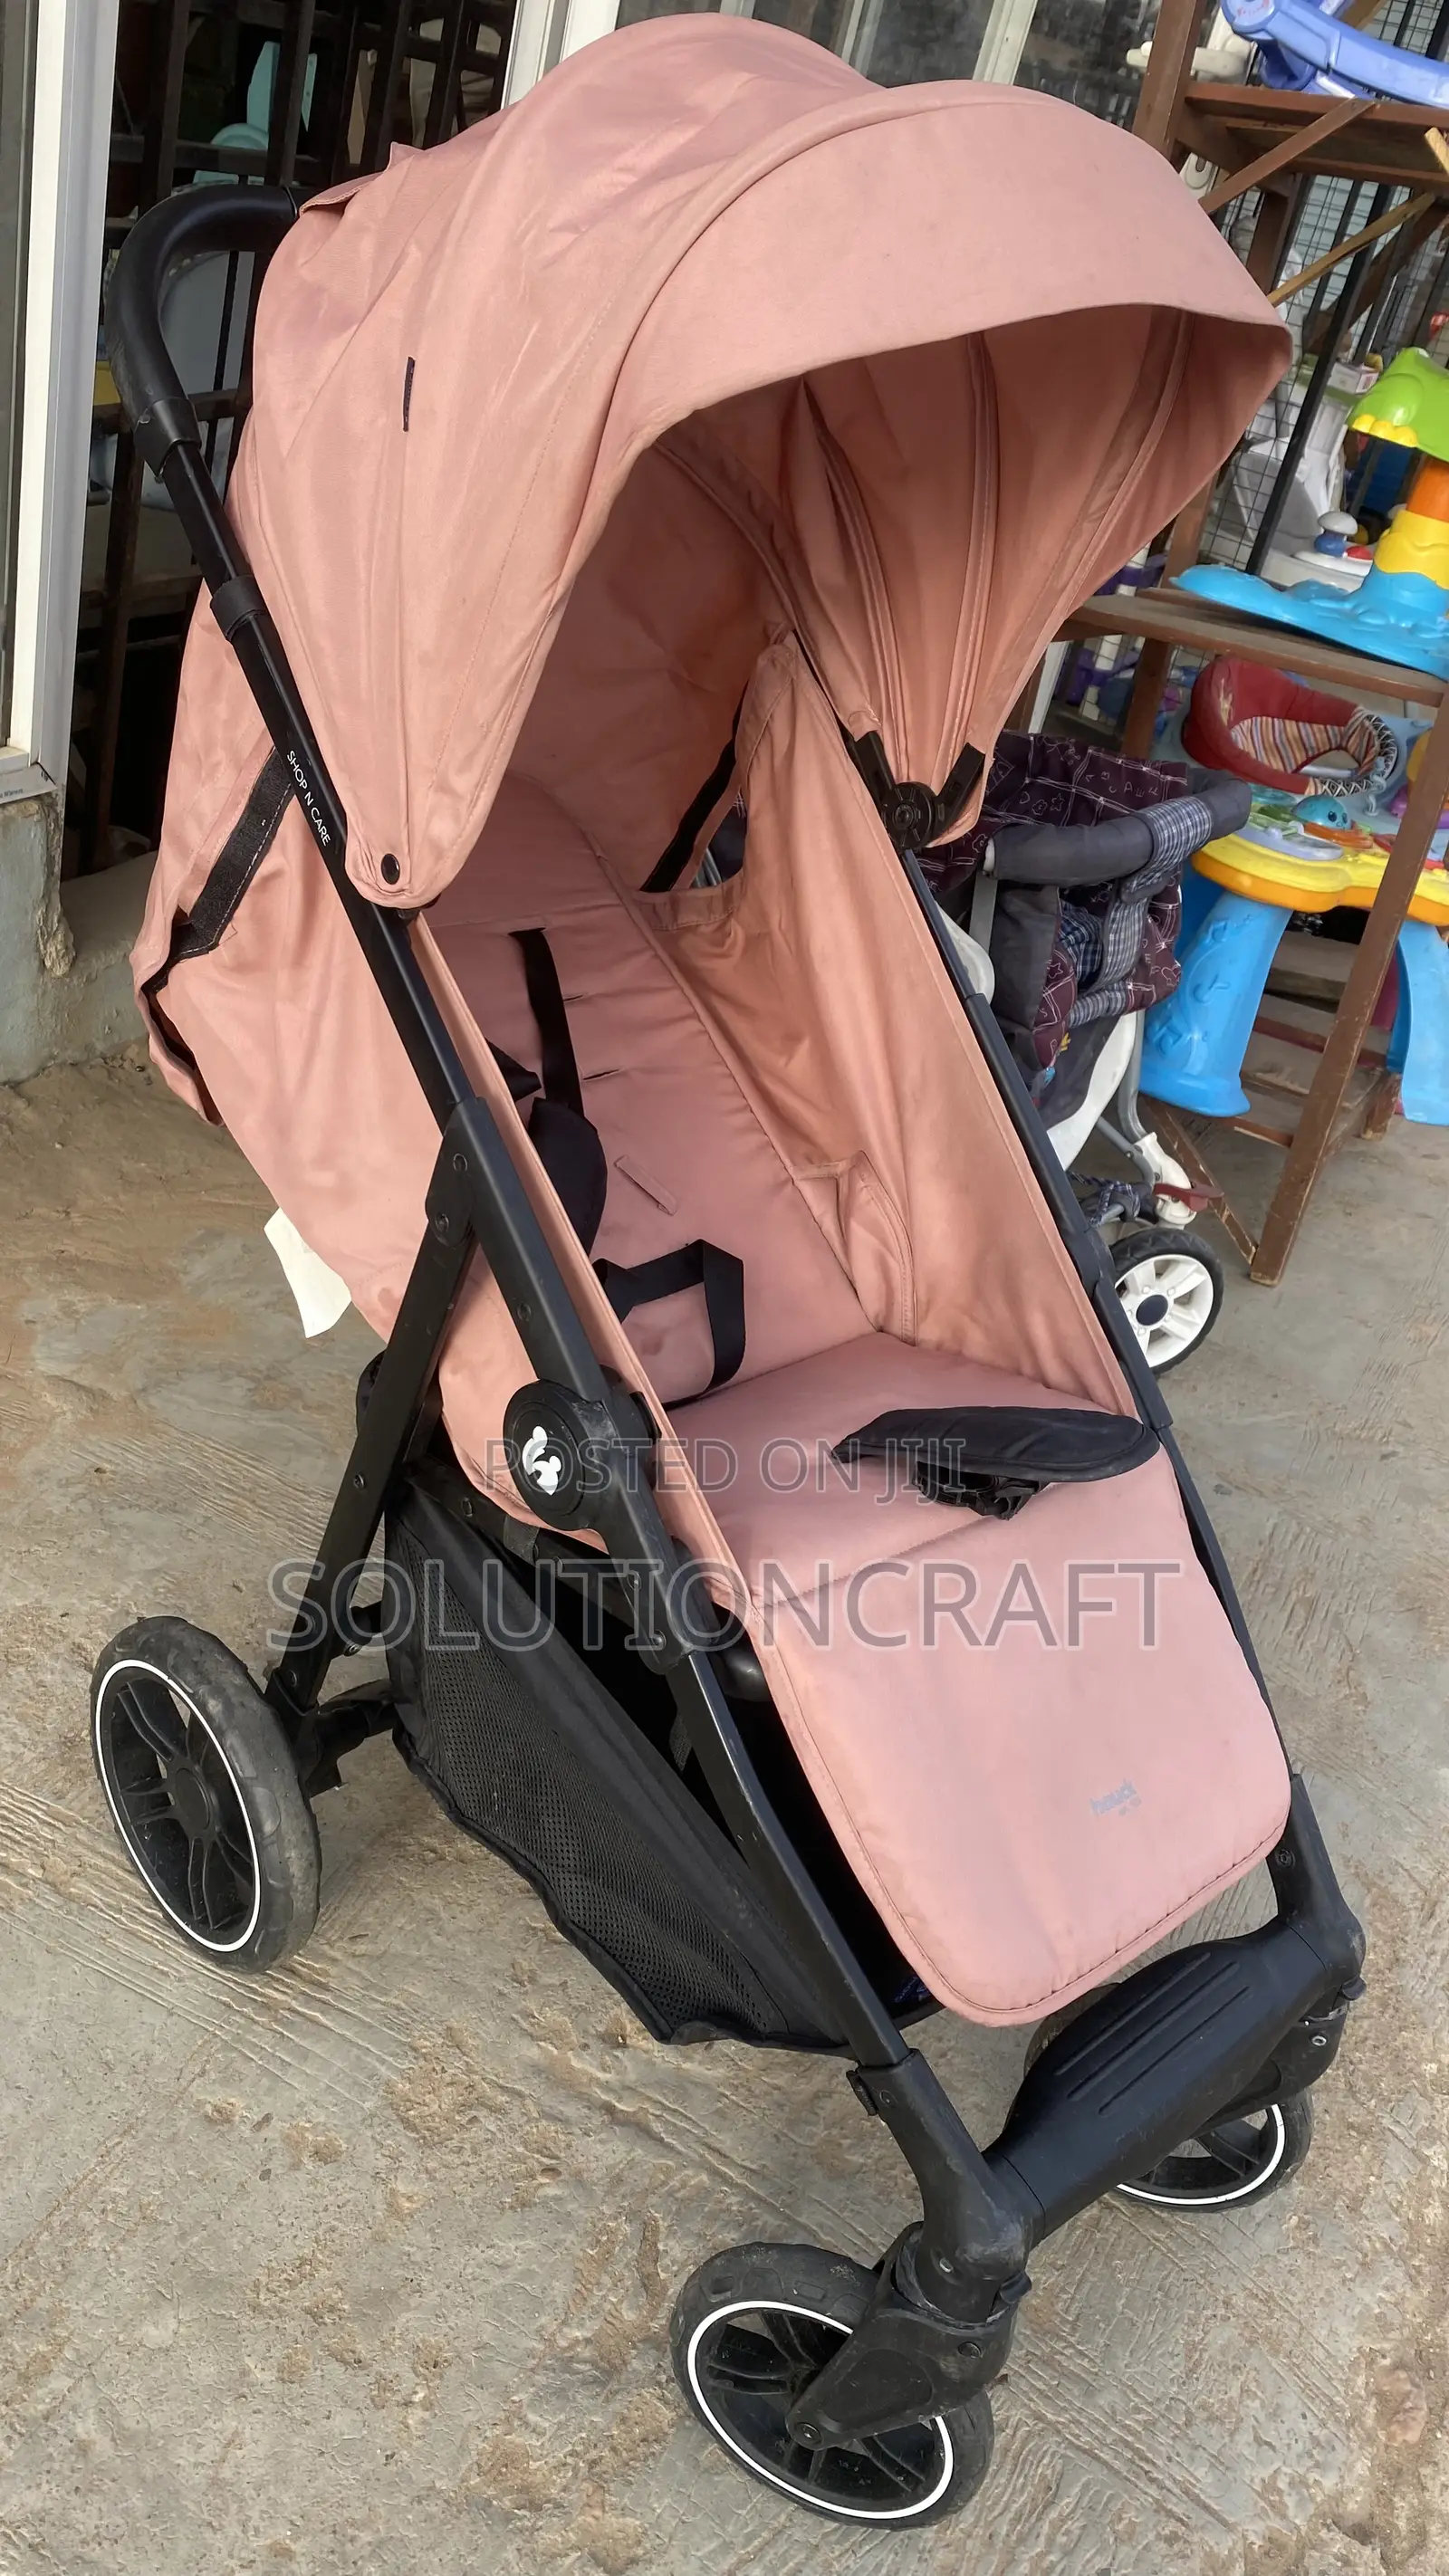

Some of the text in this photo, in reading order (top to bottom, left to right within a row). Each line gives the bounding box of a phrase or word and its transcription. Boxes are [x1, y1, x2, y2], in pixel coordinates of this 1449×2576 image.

[287, 750, 331, 847] SHOP N CARE
